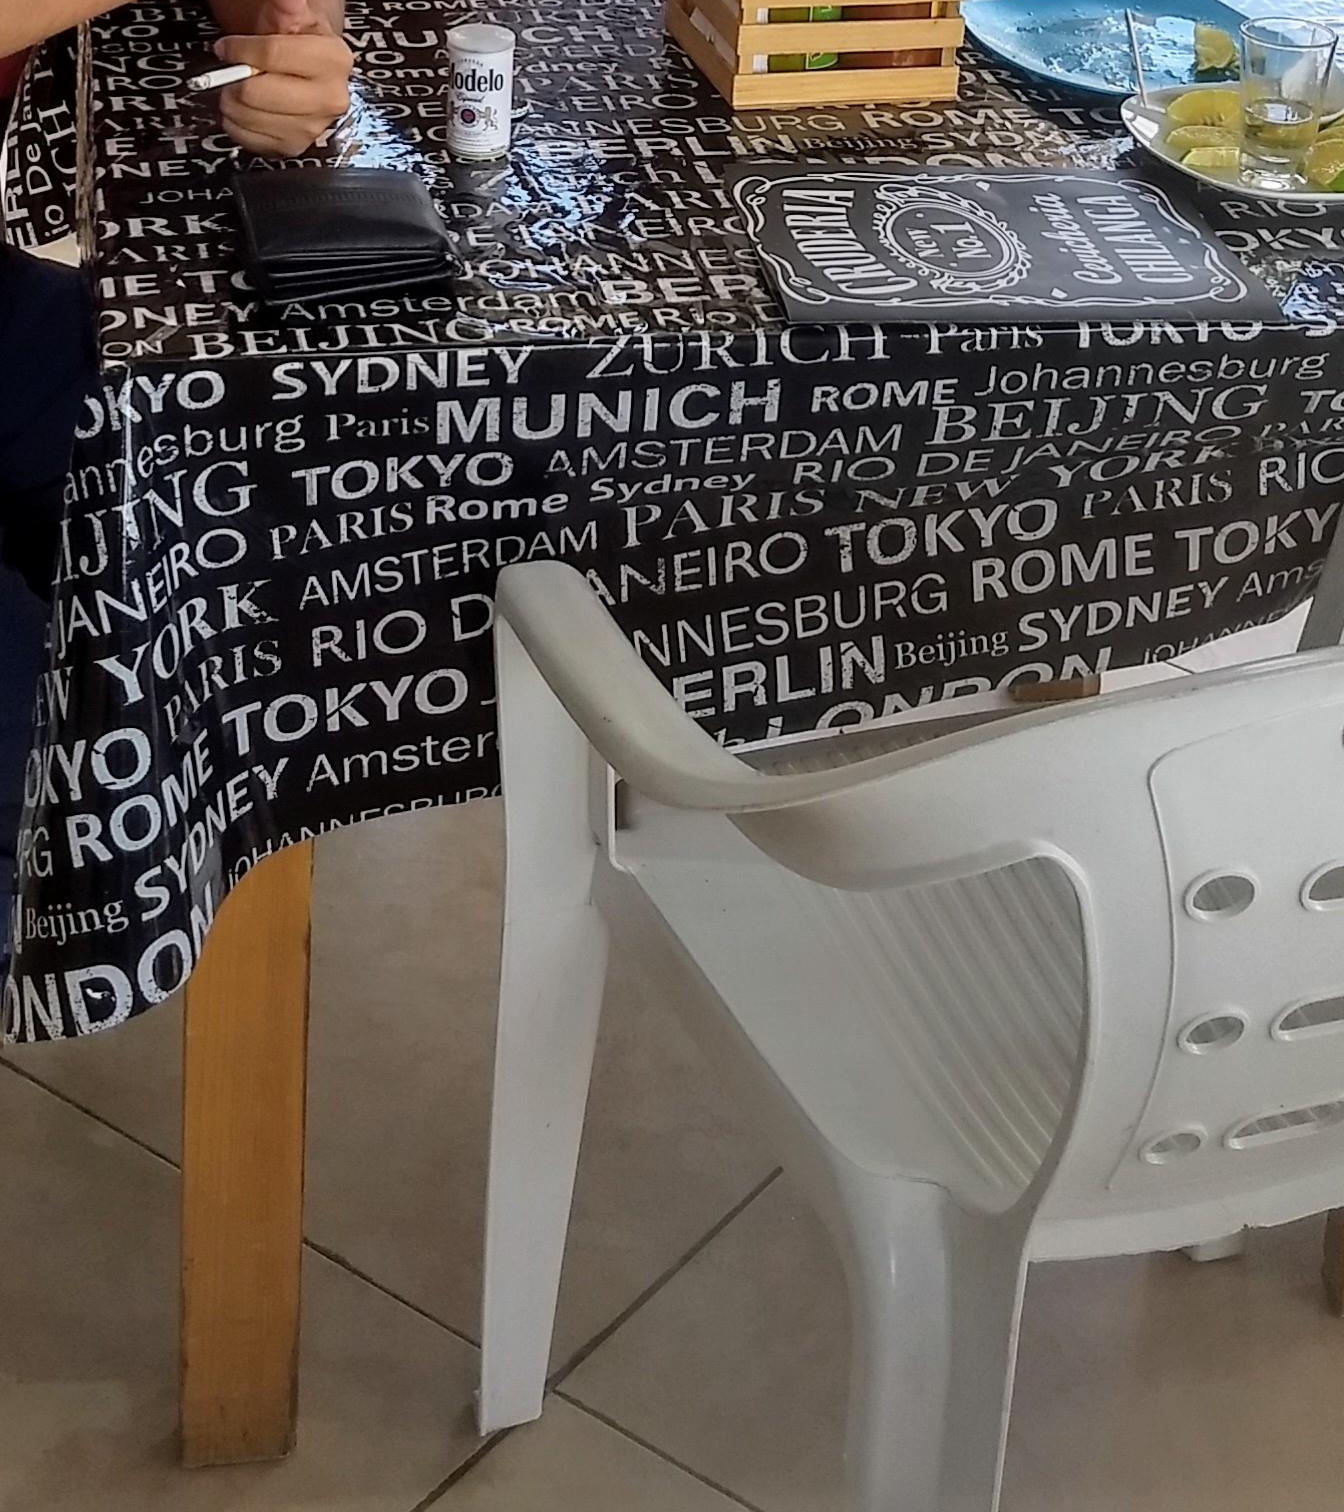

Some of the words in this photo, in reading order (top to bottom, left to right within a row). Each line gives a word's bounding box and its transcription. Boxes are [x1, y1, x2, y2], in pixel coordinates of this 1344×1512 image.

[383, 0, 489, 11] ROME
[343, 25, 615, 49] MUCH
[450, 62, 504, 93] odelo
[513, 61, 620, 76] ydney
[406, 111, 847, 143] JOANNESBURG
[861, 107, 1033, 128] ROME
[802, 134, 913, 152] Beijing
[97, 156, 229, 181] NEY
[44, 203, 70, 237] io
[98, 212, 235, 239] ORK
[580, 188, 735, 214] PARI
[98, 241, 235, 265] ARIS
[457, 248, 761, 281] JOHANNES
[782, 188, 918, 295] CRUDERIA
[905, 227, 945, 260] New
[1075, 193, 1195, 285] CHILANGA
[99, 301, 259, 333] DNEY
[280, 289, 599, 320] Amsterdam
[601, 274, 769, 305] BER
[187, 318, 495, 361] BEIJING
[74, 370, 226, 439] OKYO
[271, 345, 533, 400] SYDNEY
[585, 323, 890, 378] ZURICH
[922, 322, 1044, 355] Paris
[62, 414, 306, 504] annesburg
[325, 407, 430, 443] Paris
[436, 378, 782, 445] MUNICH
[810, 379, 959, 414] ROME
[972, 352, 1331, 396] Johannesburg
[52, 460, 258, 585] IJING
[291, 451, 515, 506] TOKYO
[545, 423, 903, 479] AMSTERDAM
[925, 384, 1269, 446] BEIJING
[58, 527, 248, 660] JANEIRO
[268, 501, 414, 562] PARIS
[425, 491, 569, 526] Rome
[589, 470, 757, 504] Sydney
[792, 454, 897, 486] RIO
[915, 451, 999, 478] DE
[1005, 425, 1243, 480] JANEIRO
[311, 609, 427, 668] RIO
[584, 531, 809, 609] ANEIRO
[823, 496, 1058, 574] TOKYO
[1080, 469, 1233, 521] PARIS
[93, 579, 279, 706] YORK
[299, 522, 597, 610] AMSTERDAM
[622, 489, 826, 550] PARIS
[853, 475, 1017, 512] NEW
[1047, 440, 1241, 487] YORK
[632, 574, 948, 667] NNESBURG
[970, 532, 1155, 602] ROME
[1174, 502, 1342, 573] TOKY
[671, 634, 886, 720] ERLIN
[894, 629, 1011, 675] Beijing
[1016, 576, 1229, 653] SYDNEY
[222, 668, 469, 757] TOKYO
[23, 727, 152, 808] OKYO
[66, 728, 213, 869] ROME
[134, 757, 290, 922] SYDNEY
[306, 730, 503, 793] Amster
[25, 899, 130, 946] Beijing
[4, 882, 214, 1044] ONDON
